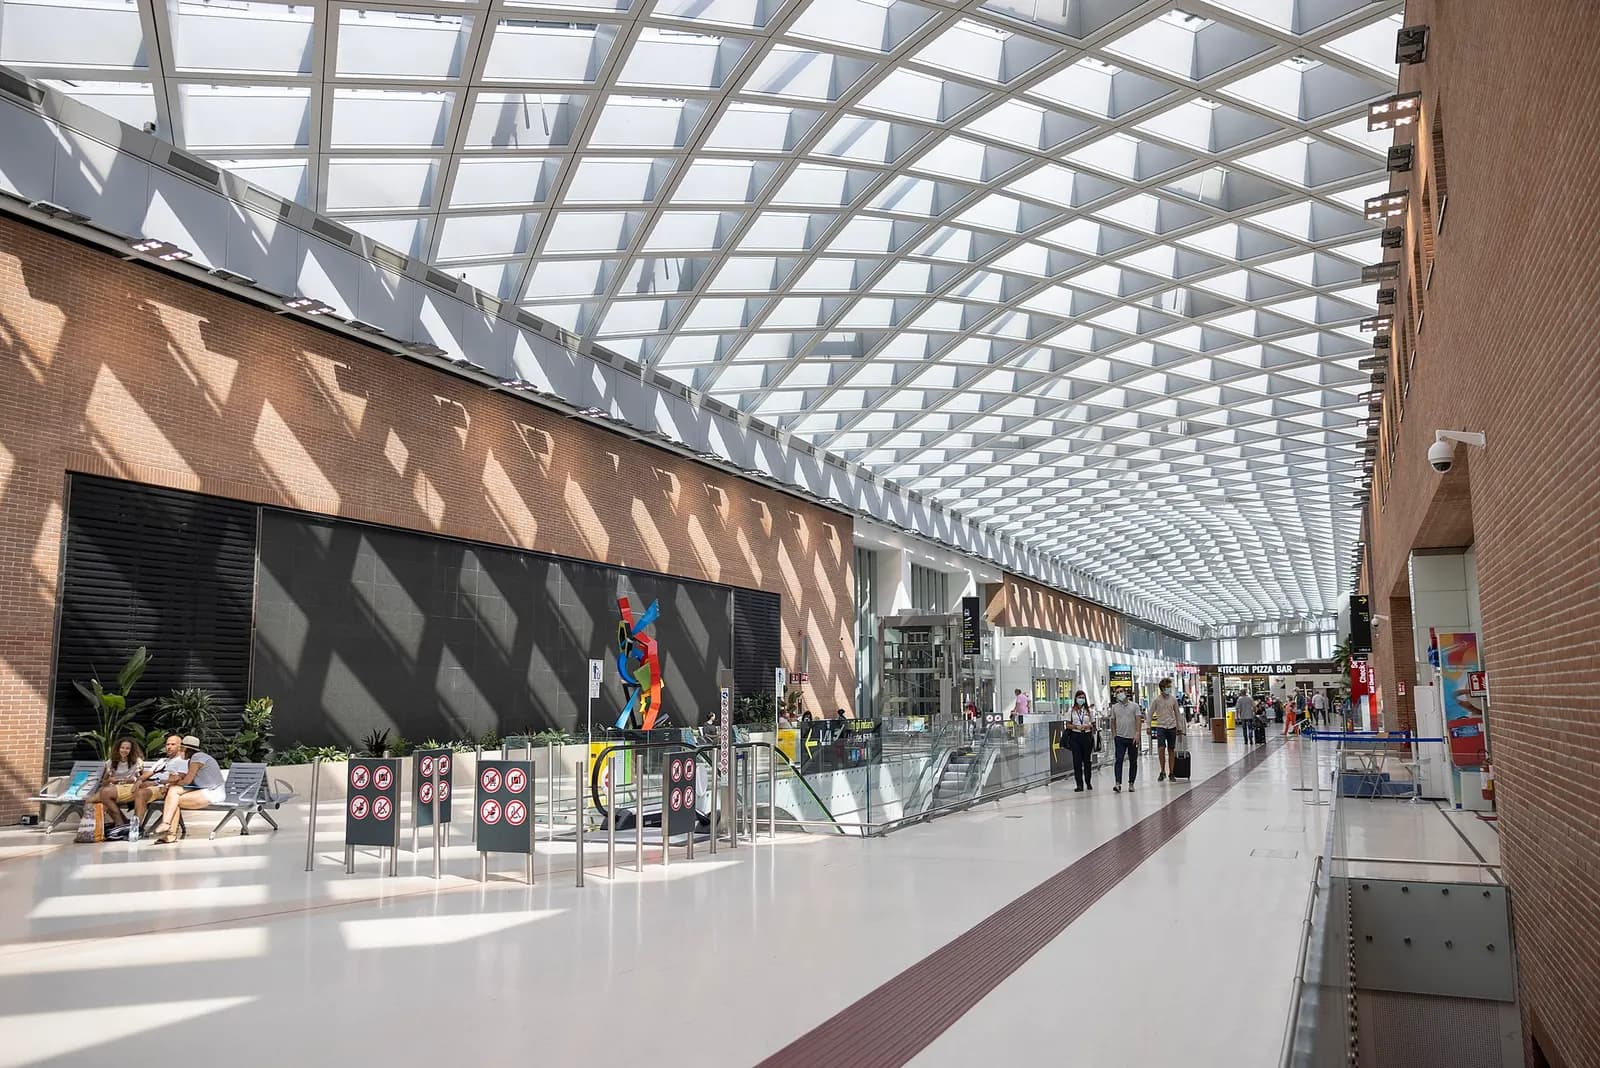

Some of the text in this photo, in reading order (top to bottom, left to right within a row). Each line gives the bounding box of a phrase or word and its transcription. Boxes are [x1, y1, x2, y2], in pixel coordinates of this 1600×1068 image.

[1218, 665, 1293, 674] KITCHEN PIZZA BAR
